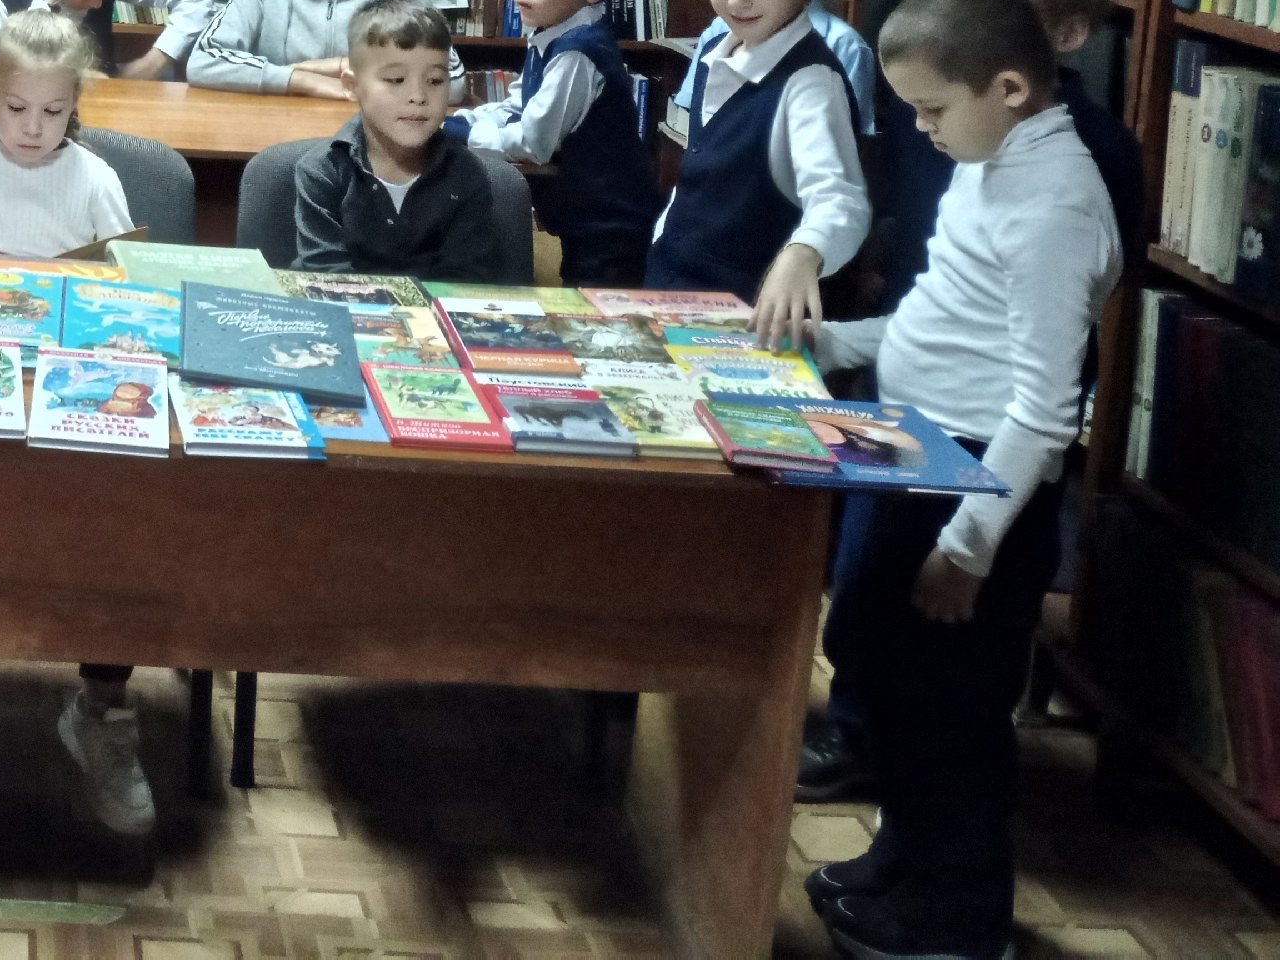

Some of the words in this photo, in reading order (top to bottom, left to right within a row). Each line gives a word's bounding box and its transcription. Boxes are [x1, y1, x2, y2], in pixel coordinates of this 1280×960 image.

[67, 413, 135, 424] СКАЗКИ
[62, 420, 139, 431] РУССКИХ
[51, 425, 149, 439] ПИСАТЕЛЕЙ
[197, 428, 284, 436] РАССКАЖУ
[397, 426, 500, 437] БЕСПРИЗОРНАЯ
